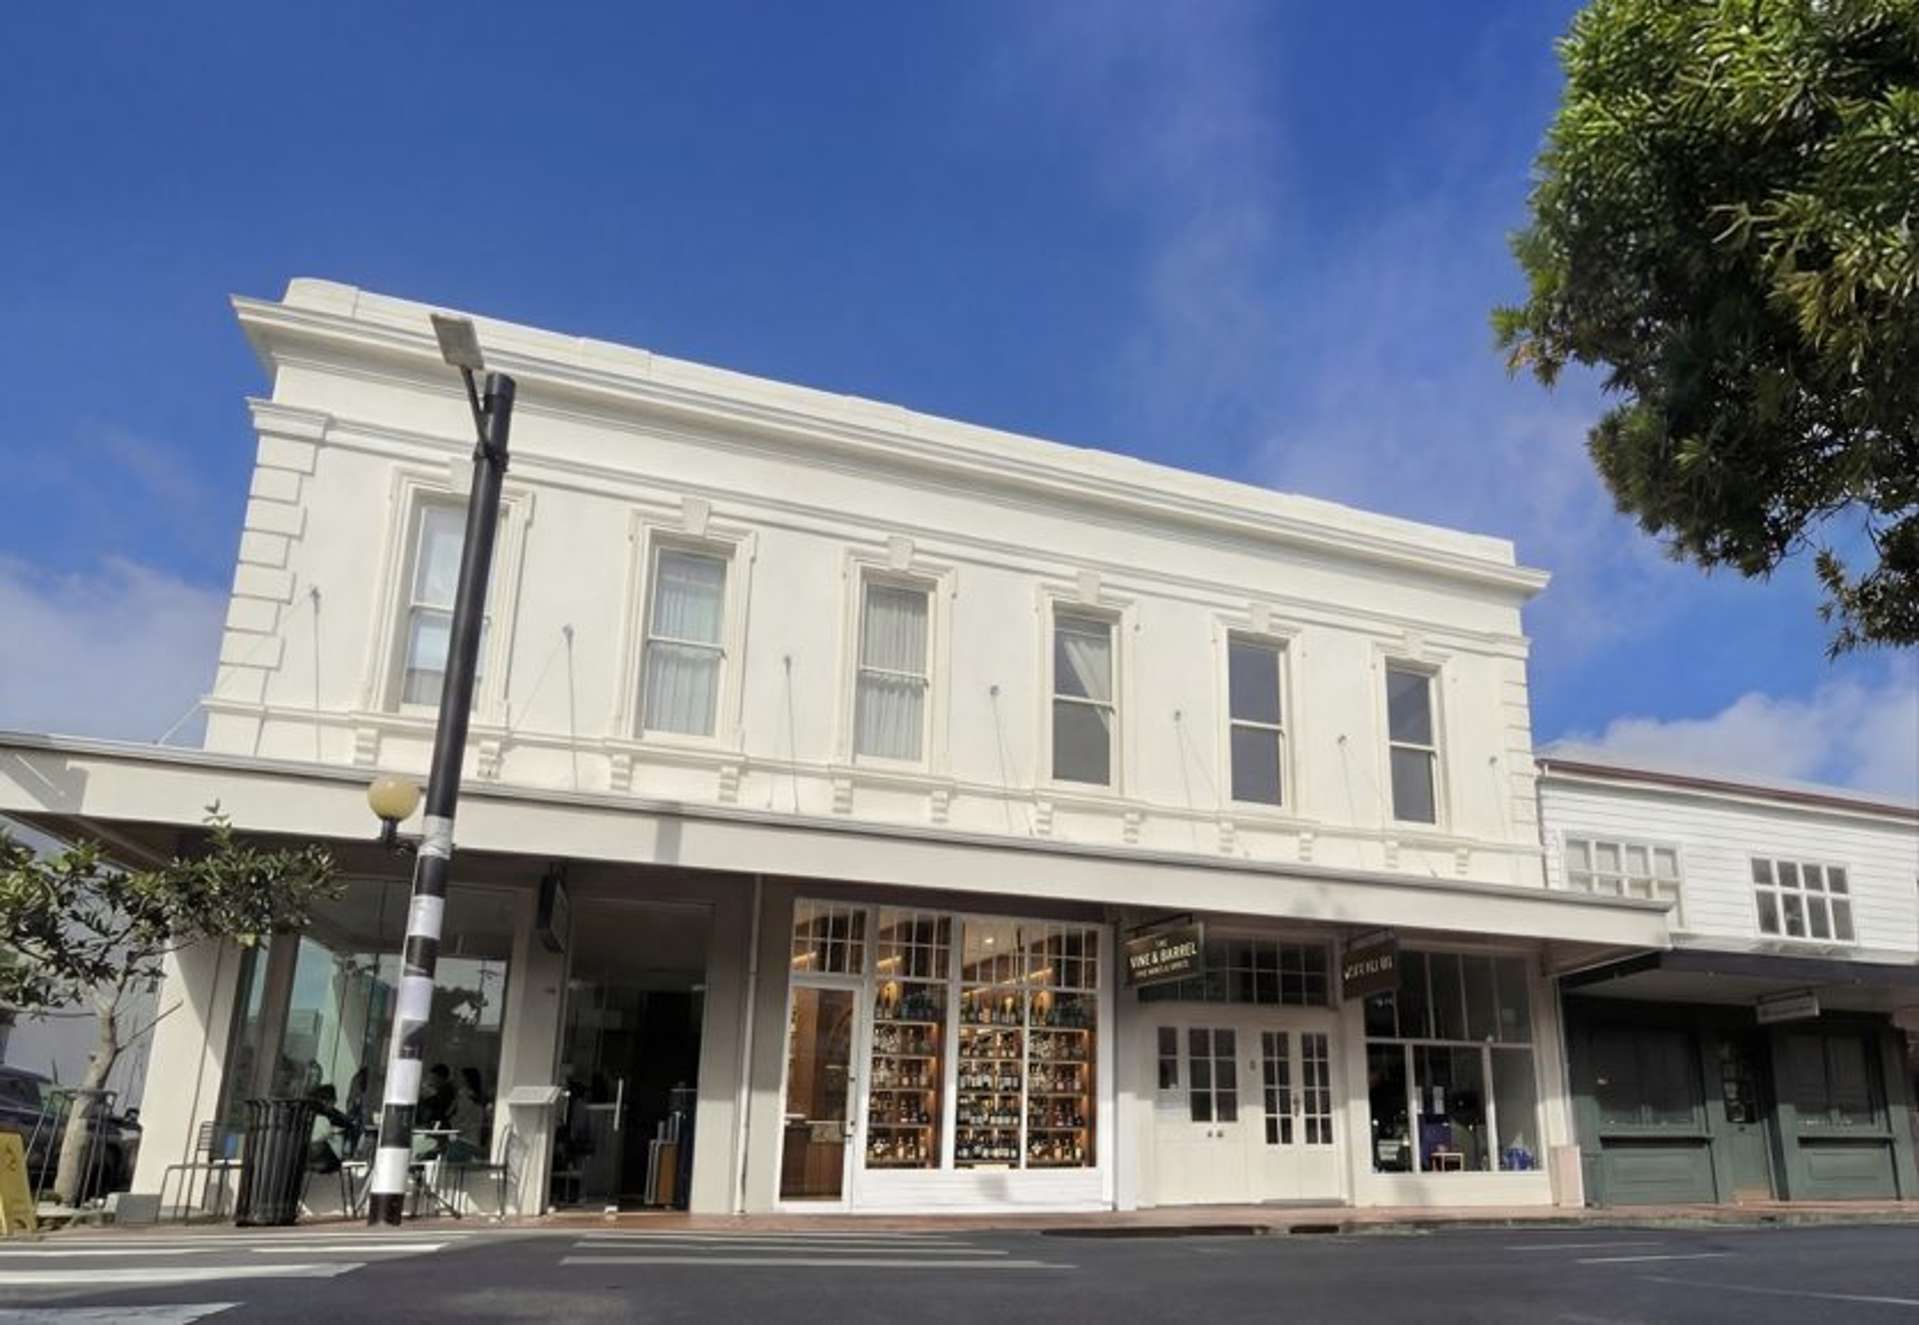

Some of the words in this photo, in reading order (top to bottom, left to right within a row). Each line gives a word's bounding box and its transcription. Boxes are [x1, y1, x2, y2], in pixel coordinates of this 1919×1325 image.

[1130, 952, 1150, 969] VINE
[1151, 950, 1159, 965] &
[1160, 942, 1197, 963] BARREL
